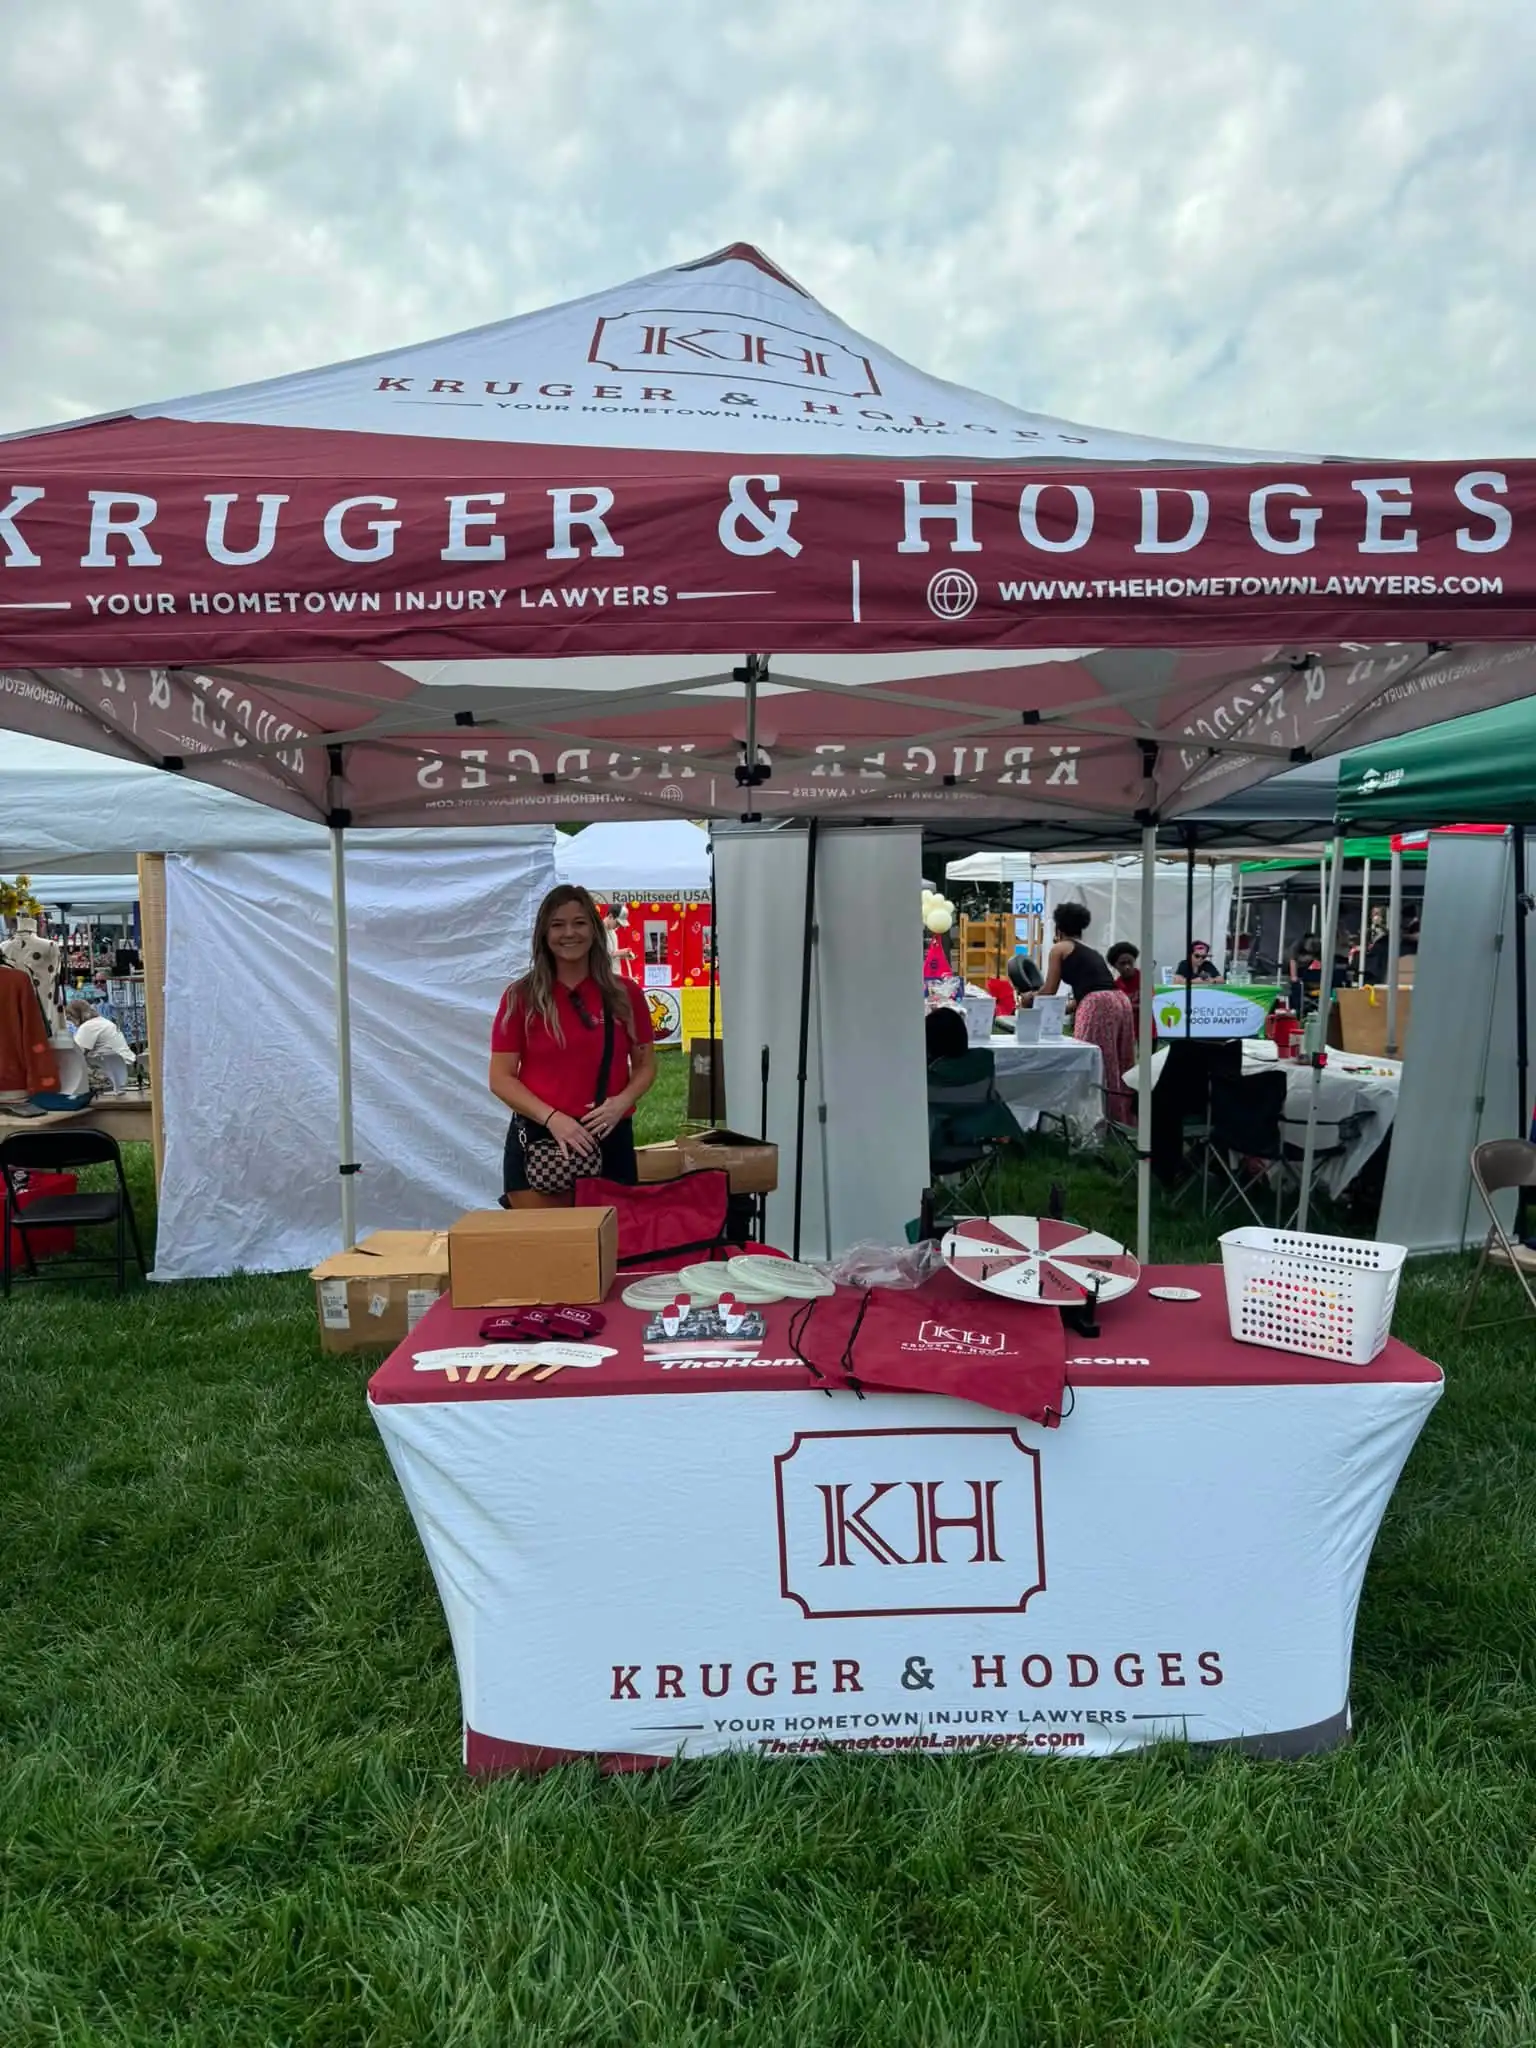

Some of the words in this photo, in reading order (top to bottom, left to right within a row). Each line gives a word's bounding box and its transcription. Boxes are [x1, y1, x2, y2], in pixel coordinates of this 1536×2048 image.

[637, 325, 838, 379] KH
[373, 377, 677, 401] KRUGER
[720, 391, 760, 408] &
[496, 402, 570, 412] YOUR
[581, 405, 741, 418] HOMETOWN
[717, 474, 804, 558] &
[896, 471, 1514, 555] HODGES
[86, 594, 178, 615] YOUR
[190, 592, 382, 613] HOMETOWN
[395, 588, 506, 611] INJURY
[520, 585, 669, 608] LAWYERS
[998, 576, 1504, 602] WWW.THEHOMETOWNLAWYERS.COM
[612, 891, 680, 902] Rabbitseed
[684, 890, 710, 901] USA
[1189, 1006, 1215, 1017] PEN
[1217, 1006, 1249, 1017] DOOR
[1190, 1017, 1211, 1026] OOD
[1213, 1017, 1248, 1025] PANTRY
[933, 1325, 993, 1345] KH
[815, 1480, 1006, 1567] KH
[610, 1658, 864, 1701] KRUGER
[900, 1655, 935, 1691] &
[972, 1651, 1224, 1688] HODGES
[714, 1718, 776, 1733] YOUR
[784, 1711, 919, 1731] HOMETOWN
[928, 1710, 1009, 1725] INJURY
[1018, 1709, 1128, 1724] LAWYERS
[757, 1730, 1085, 1754] TheHometownLawyers.com
